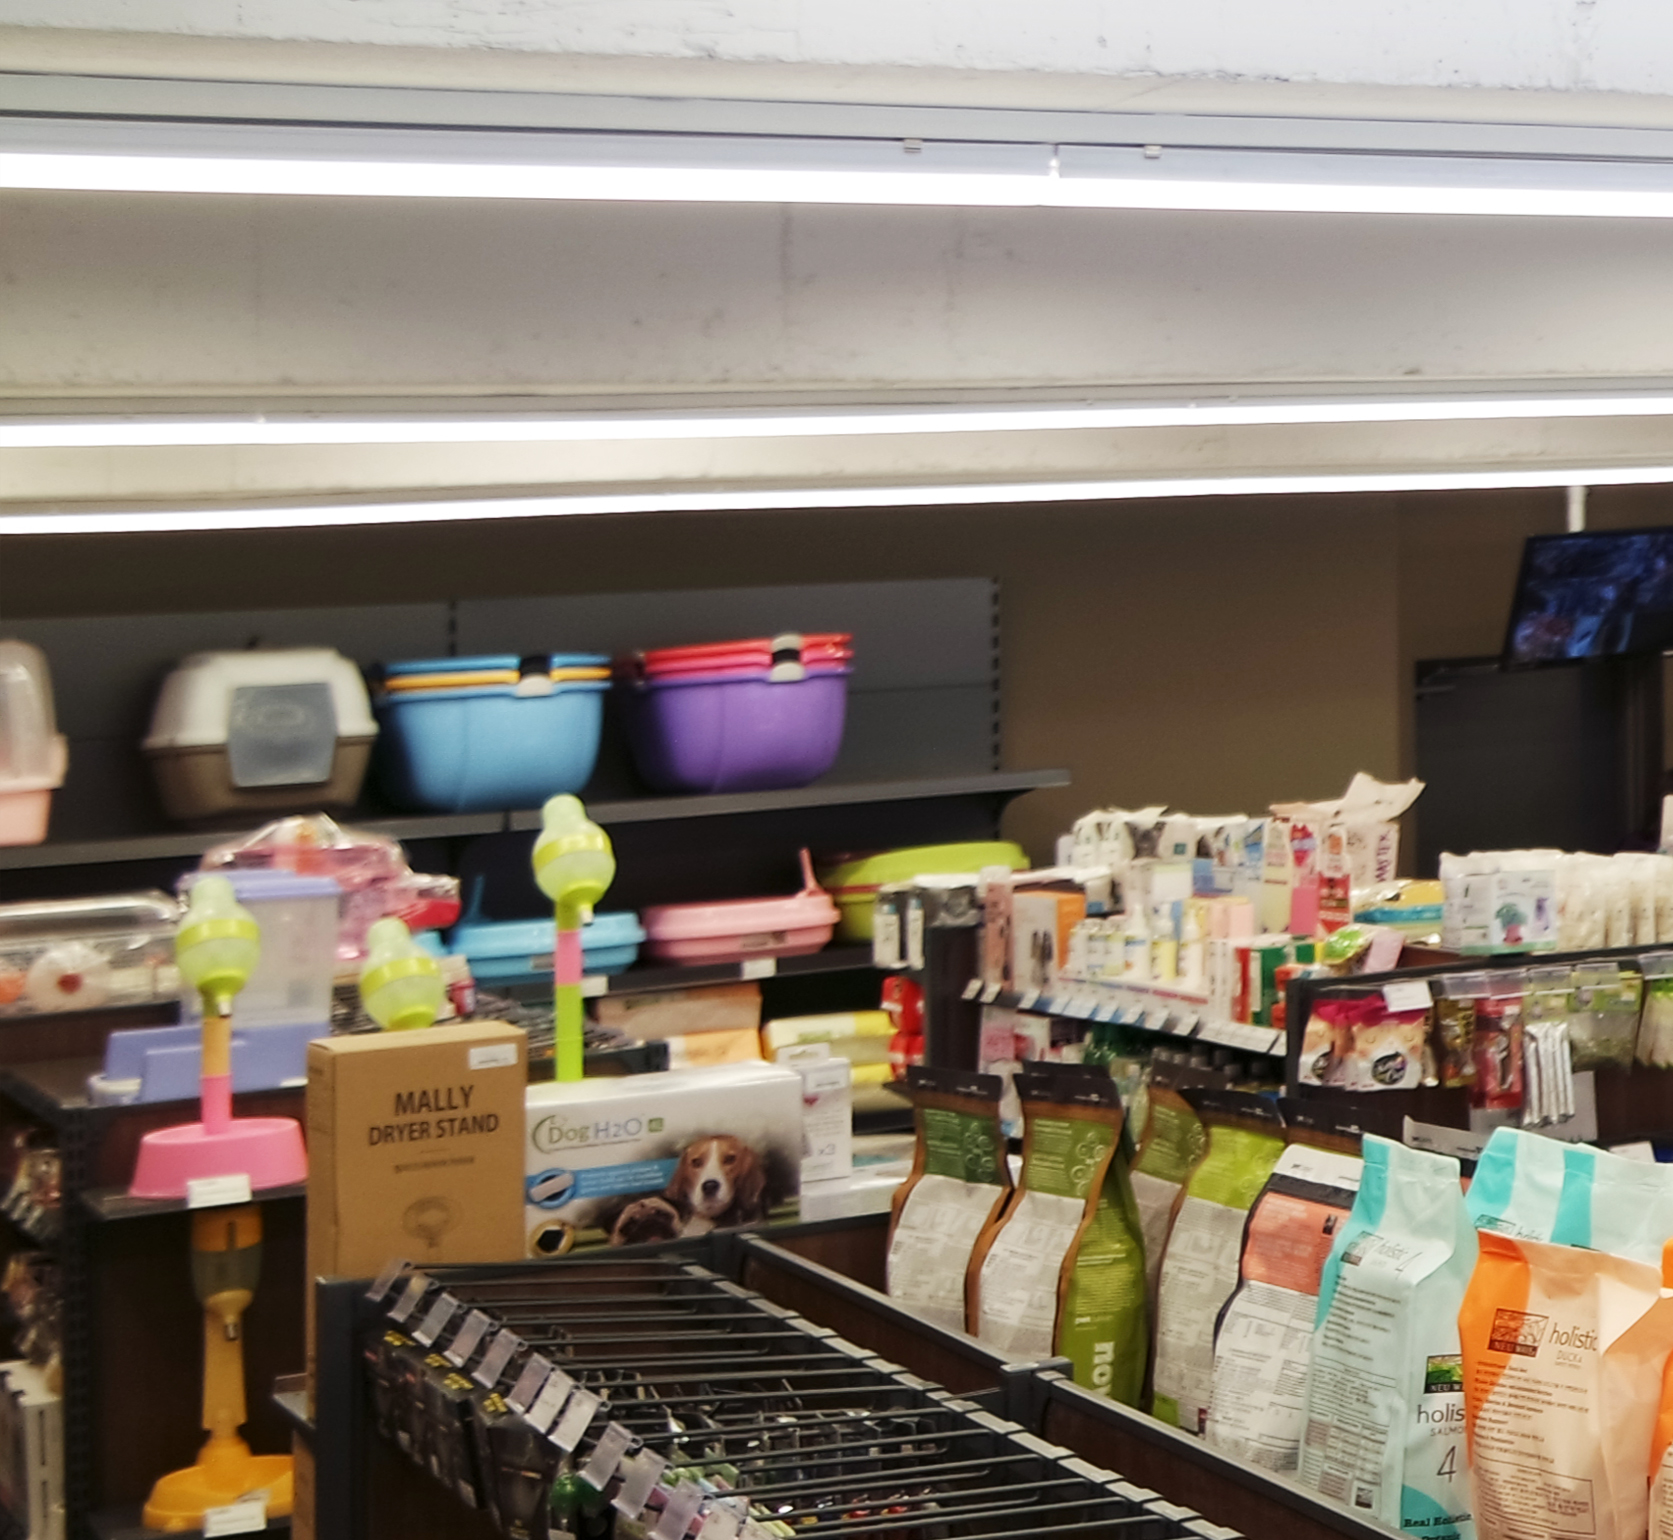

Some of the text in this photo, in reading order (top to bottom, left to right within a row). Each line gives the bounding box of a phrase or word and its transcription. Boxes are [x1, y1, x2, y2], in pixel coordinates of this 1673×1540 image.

[395, 1085, 474, 1116] MALLY
[369, 1114, 499, 1146] DRYER STAND
[549, 1123, 590, 1144] Dog
[1436, 1445, 1457, 1483] 4
[1403, 1517, 1431, 1528] Real
